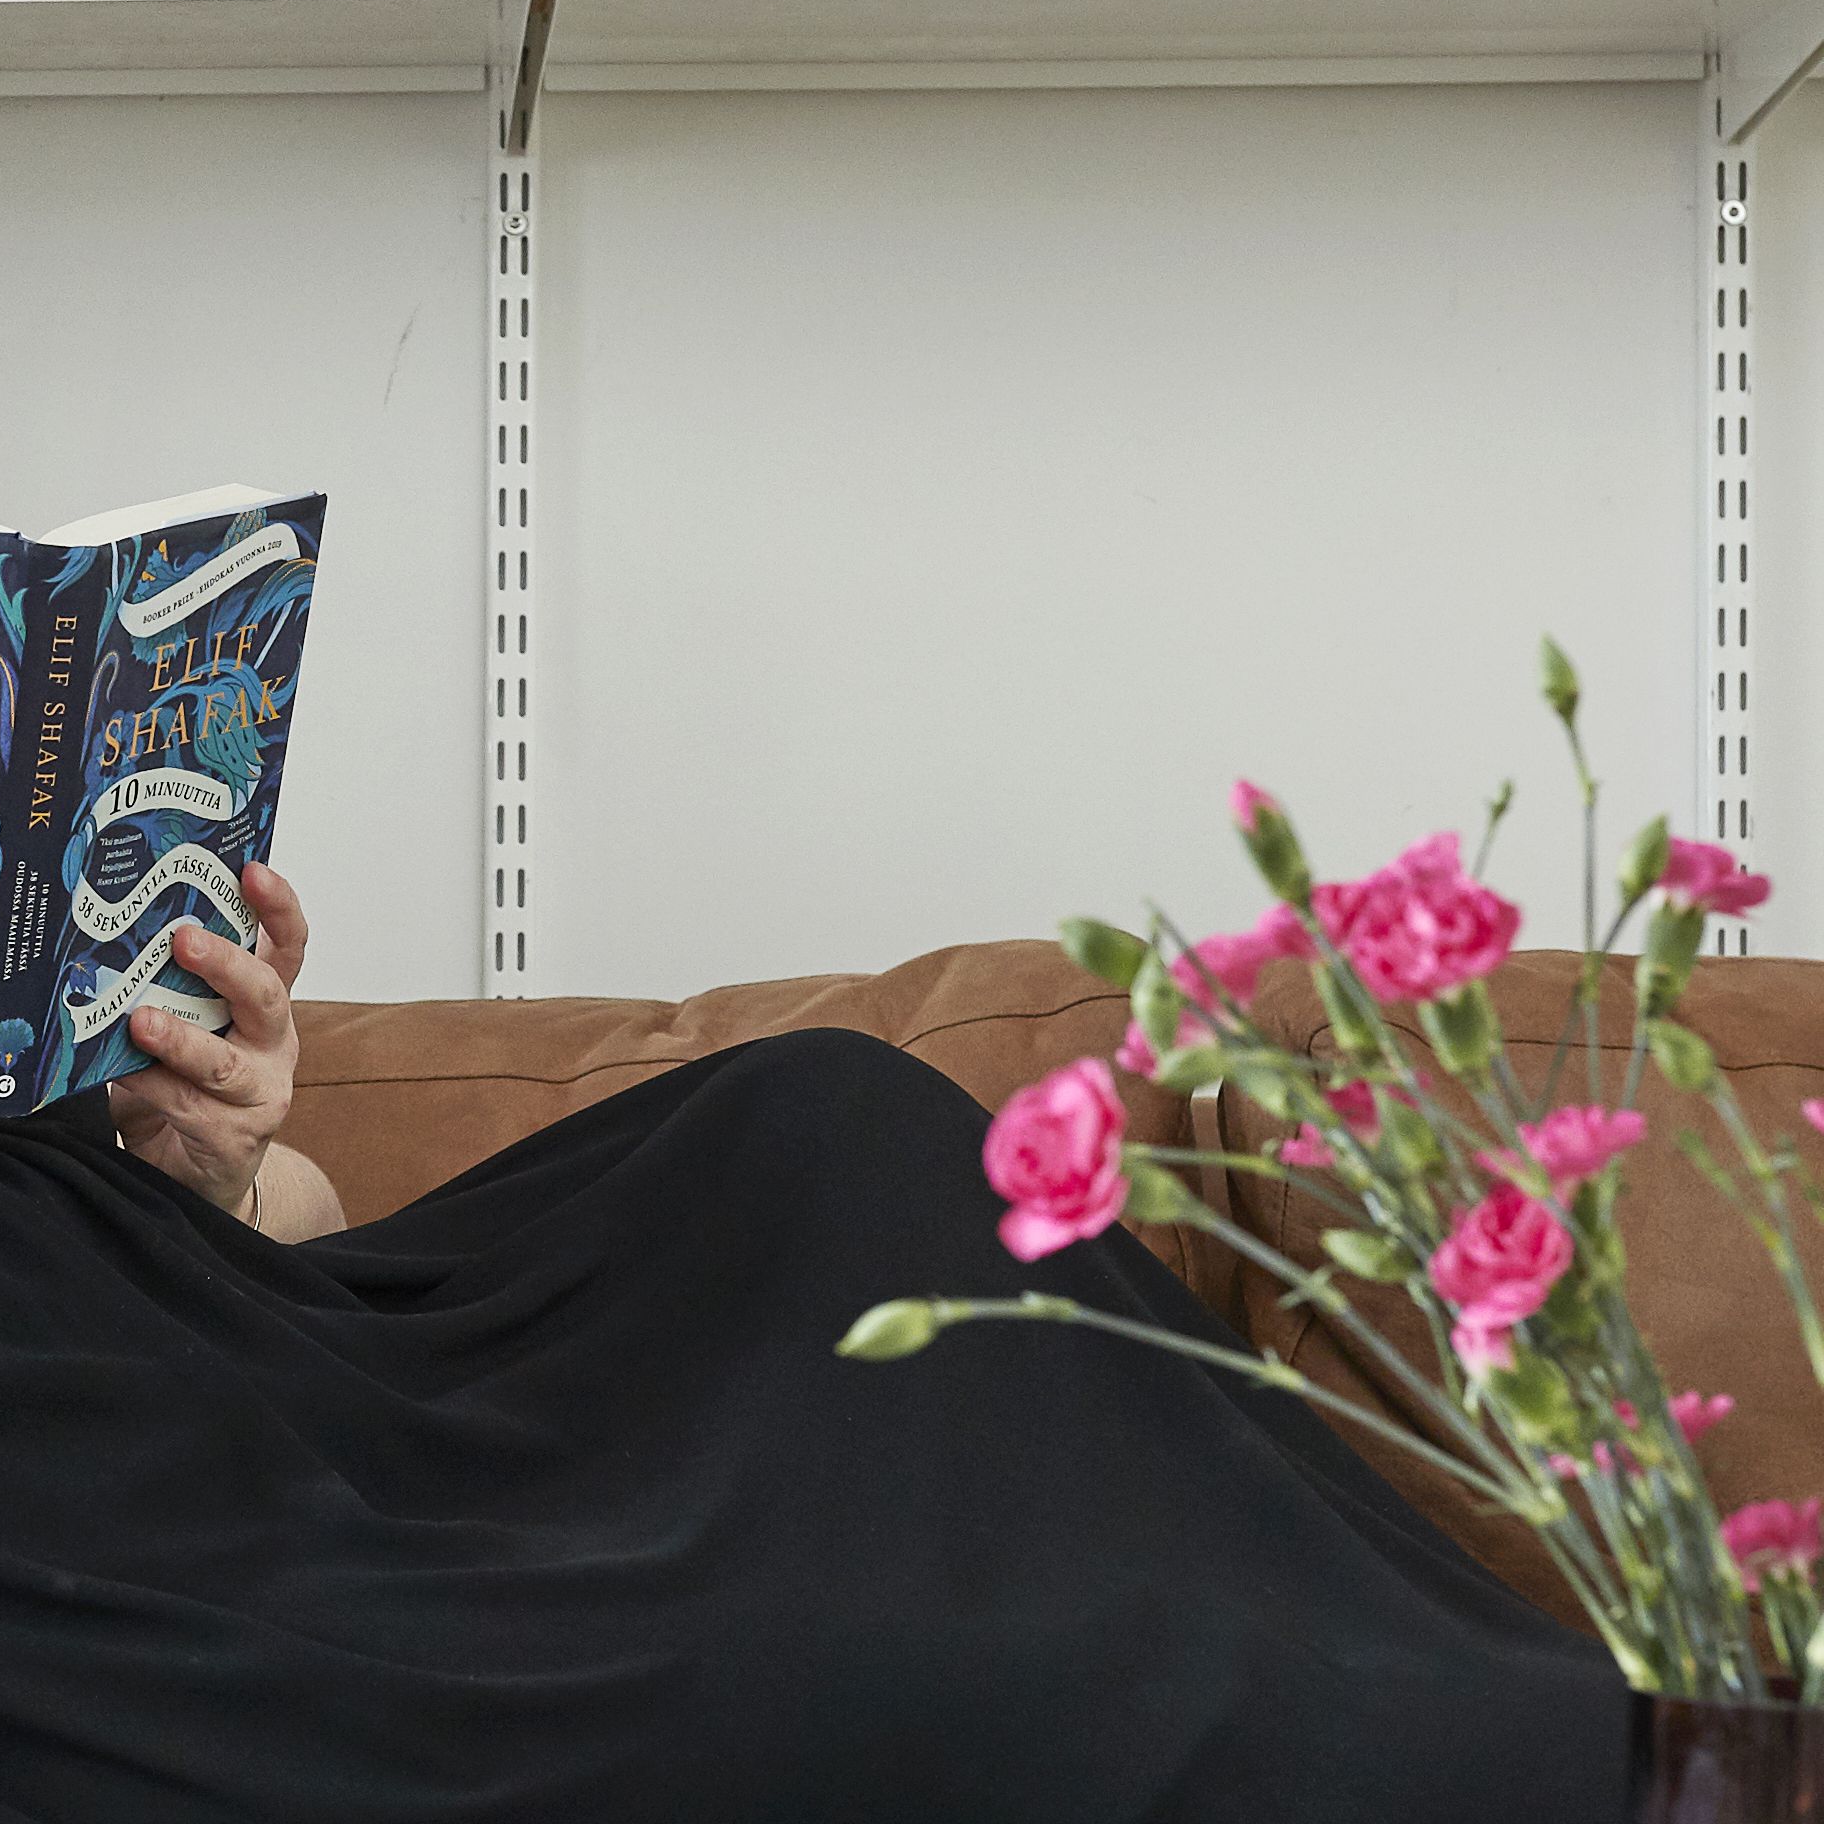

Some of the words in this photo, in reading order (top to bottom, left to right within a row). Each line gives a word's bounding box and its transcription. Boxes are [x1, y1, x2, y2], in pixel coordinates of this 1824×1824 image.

[48, 615, 77, 686] ELIF
[149, 624, 258, 692] ELIF
[99, 676, 286, 767] SHAFAK
[28, 702, 66, 830] SHAFAK
[109, 779, 139, 815] 10
[144, 781, 221, 810] MINUUTTIA
[78, 896, 94, 920] 38
[93, 868, 167, 932] SEKUNTIA
[173, 856, 212, 881] TÄSSÄ
[211, 876, 252, 936] OUDOSSA
